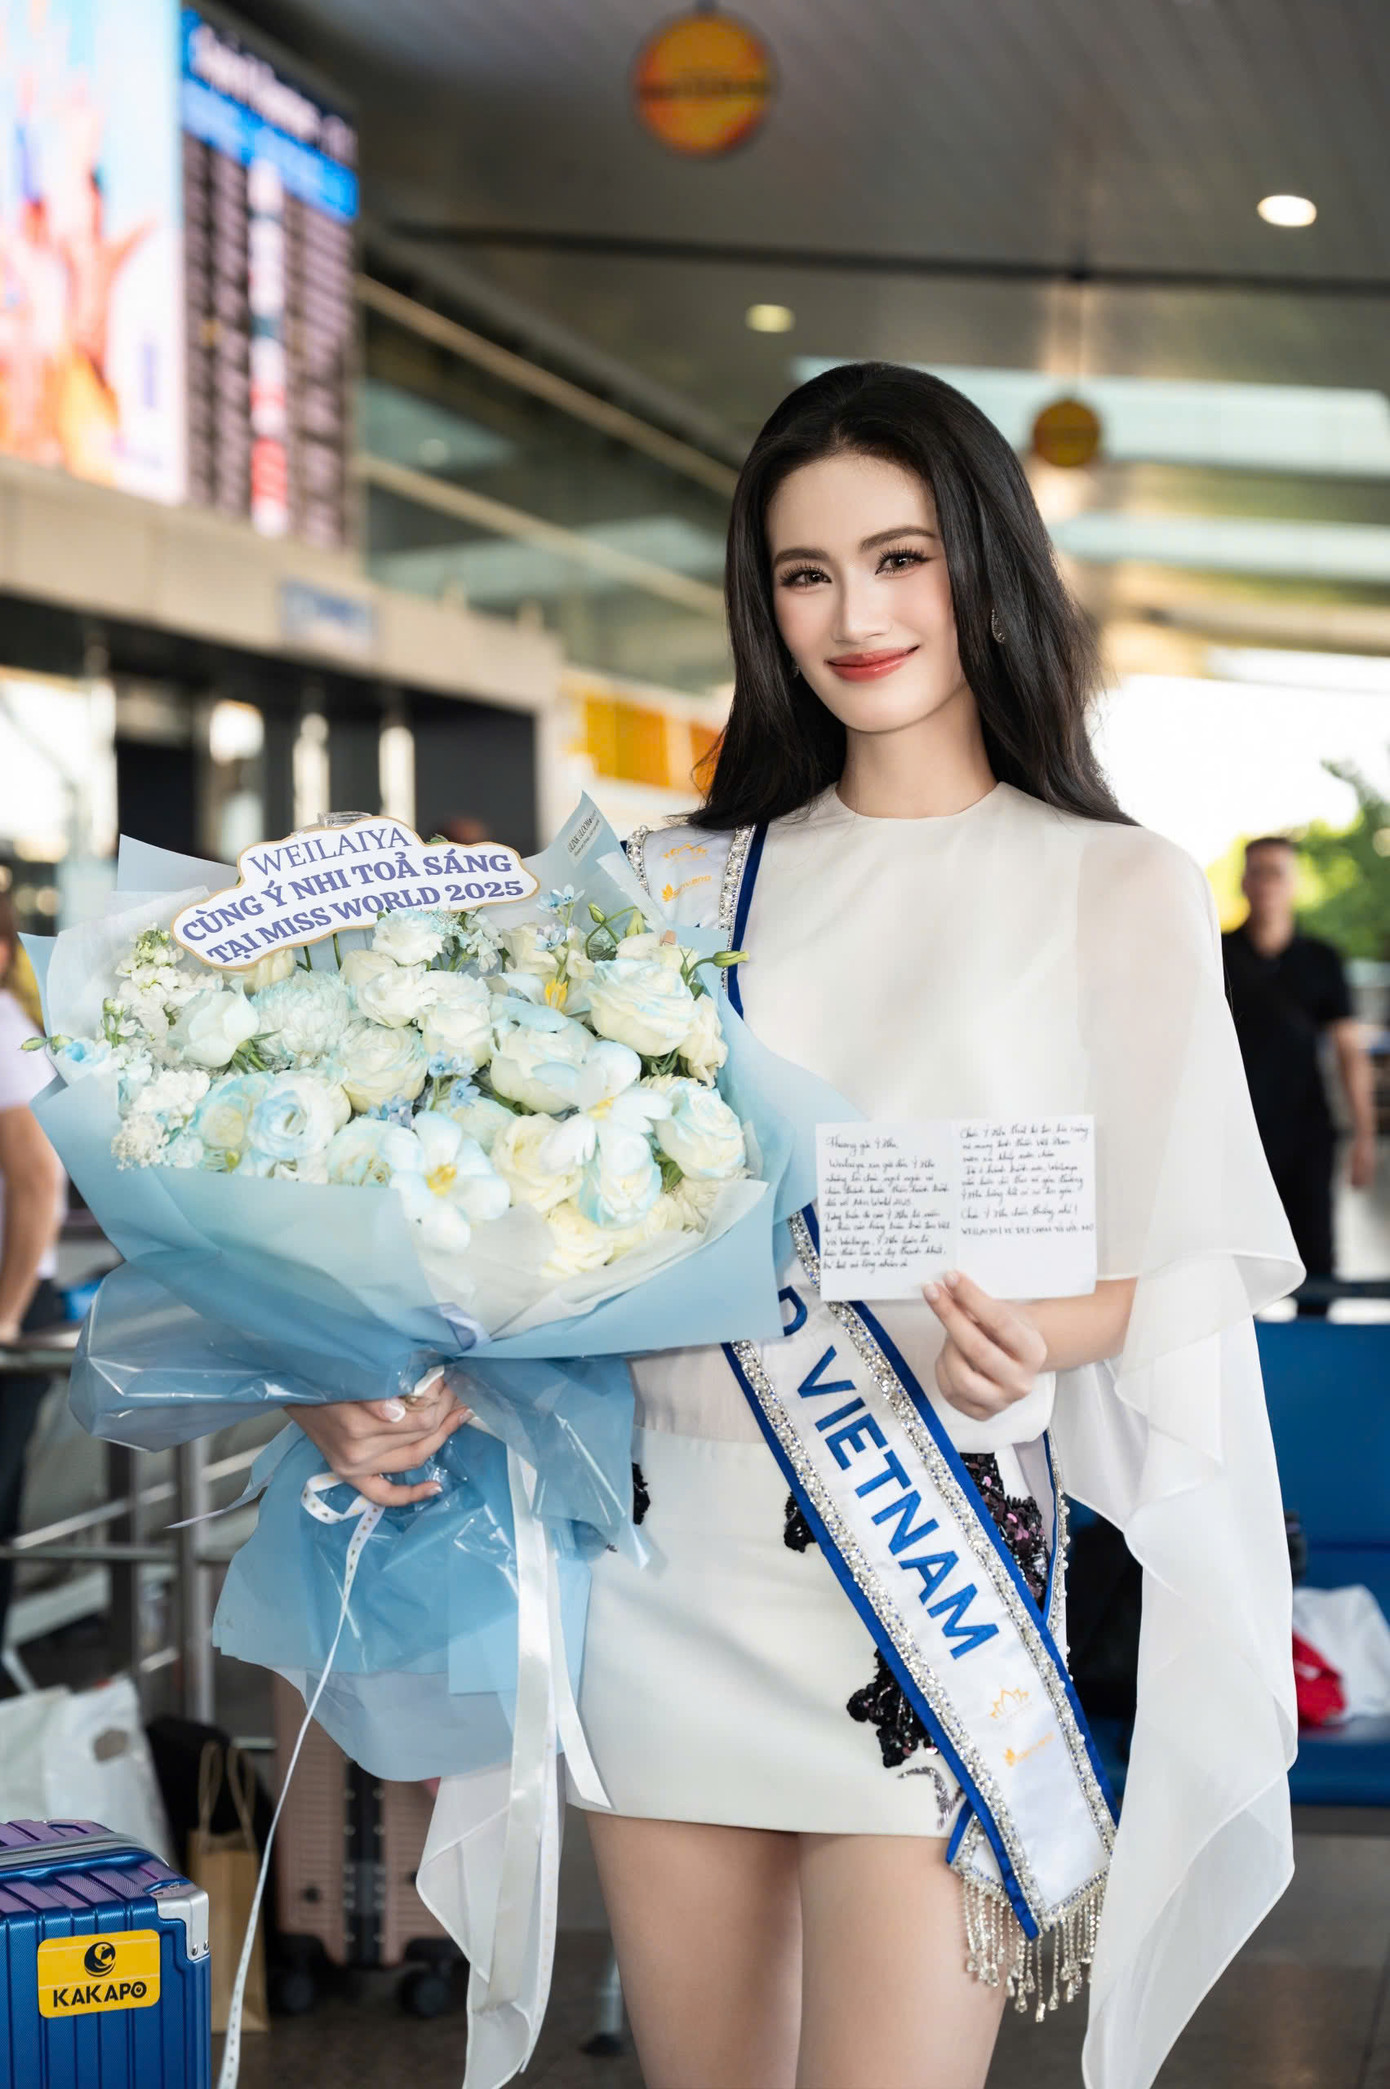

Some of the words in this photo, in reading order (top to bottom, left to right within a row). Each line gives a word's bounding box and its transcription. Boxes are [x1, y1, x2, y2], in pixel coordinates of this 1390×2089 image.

[248, 827, 412, 876] WEILAIYA
[182, 895, 265, 941] CÙNG
[261, 880, 287, 907] Ý
[288, 869, 351, 900] NHI
[351, 852, 420, 885] TOẢ
[422, 848, 512, 876] SÁNG
[206, 932, 261, 963] TẠI
[255, 907, 332, 944] MISS
[329, 886, 441, 920] WORLD
[444, 880, 524, 902] 2025
[797, 1345, 999, 1660] VIETNAM
[53, 1981, 147, 2008] KAKAPO
